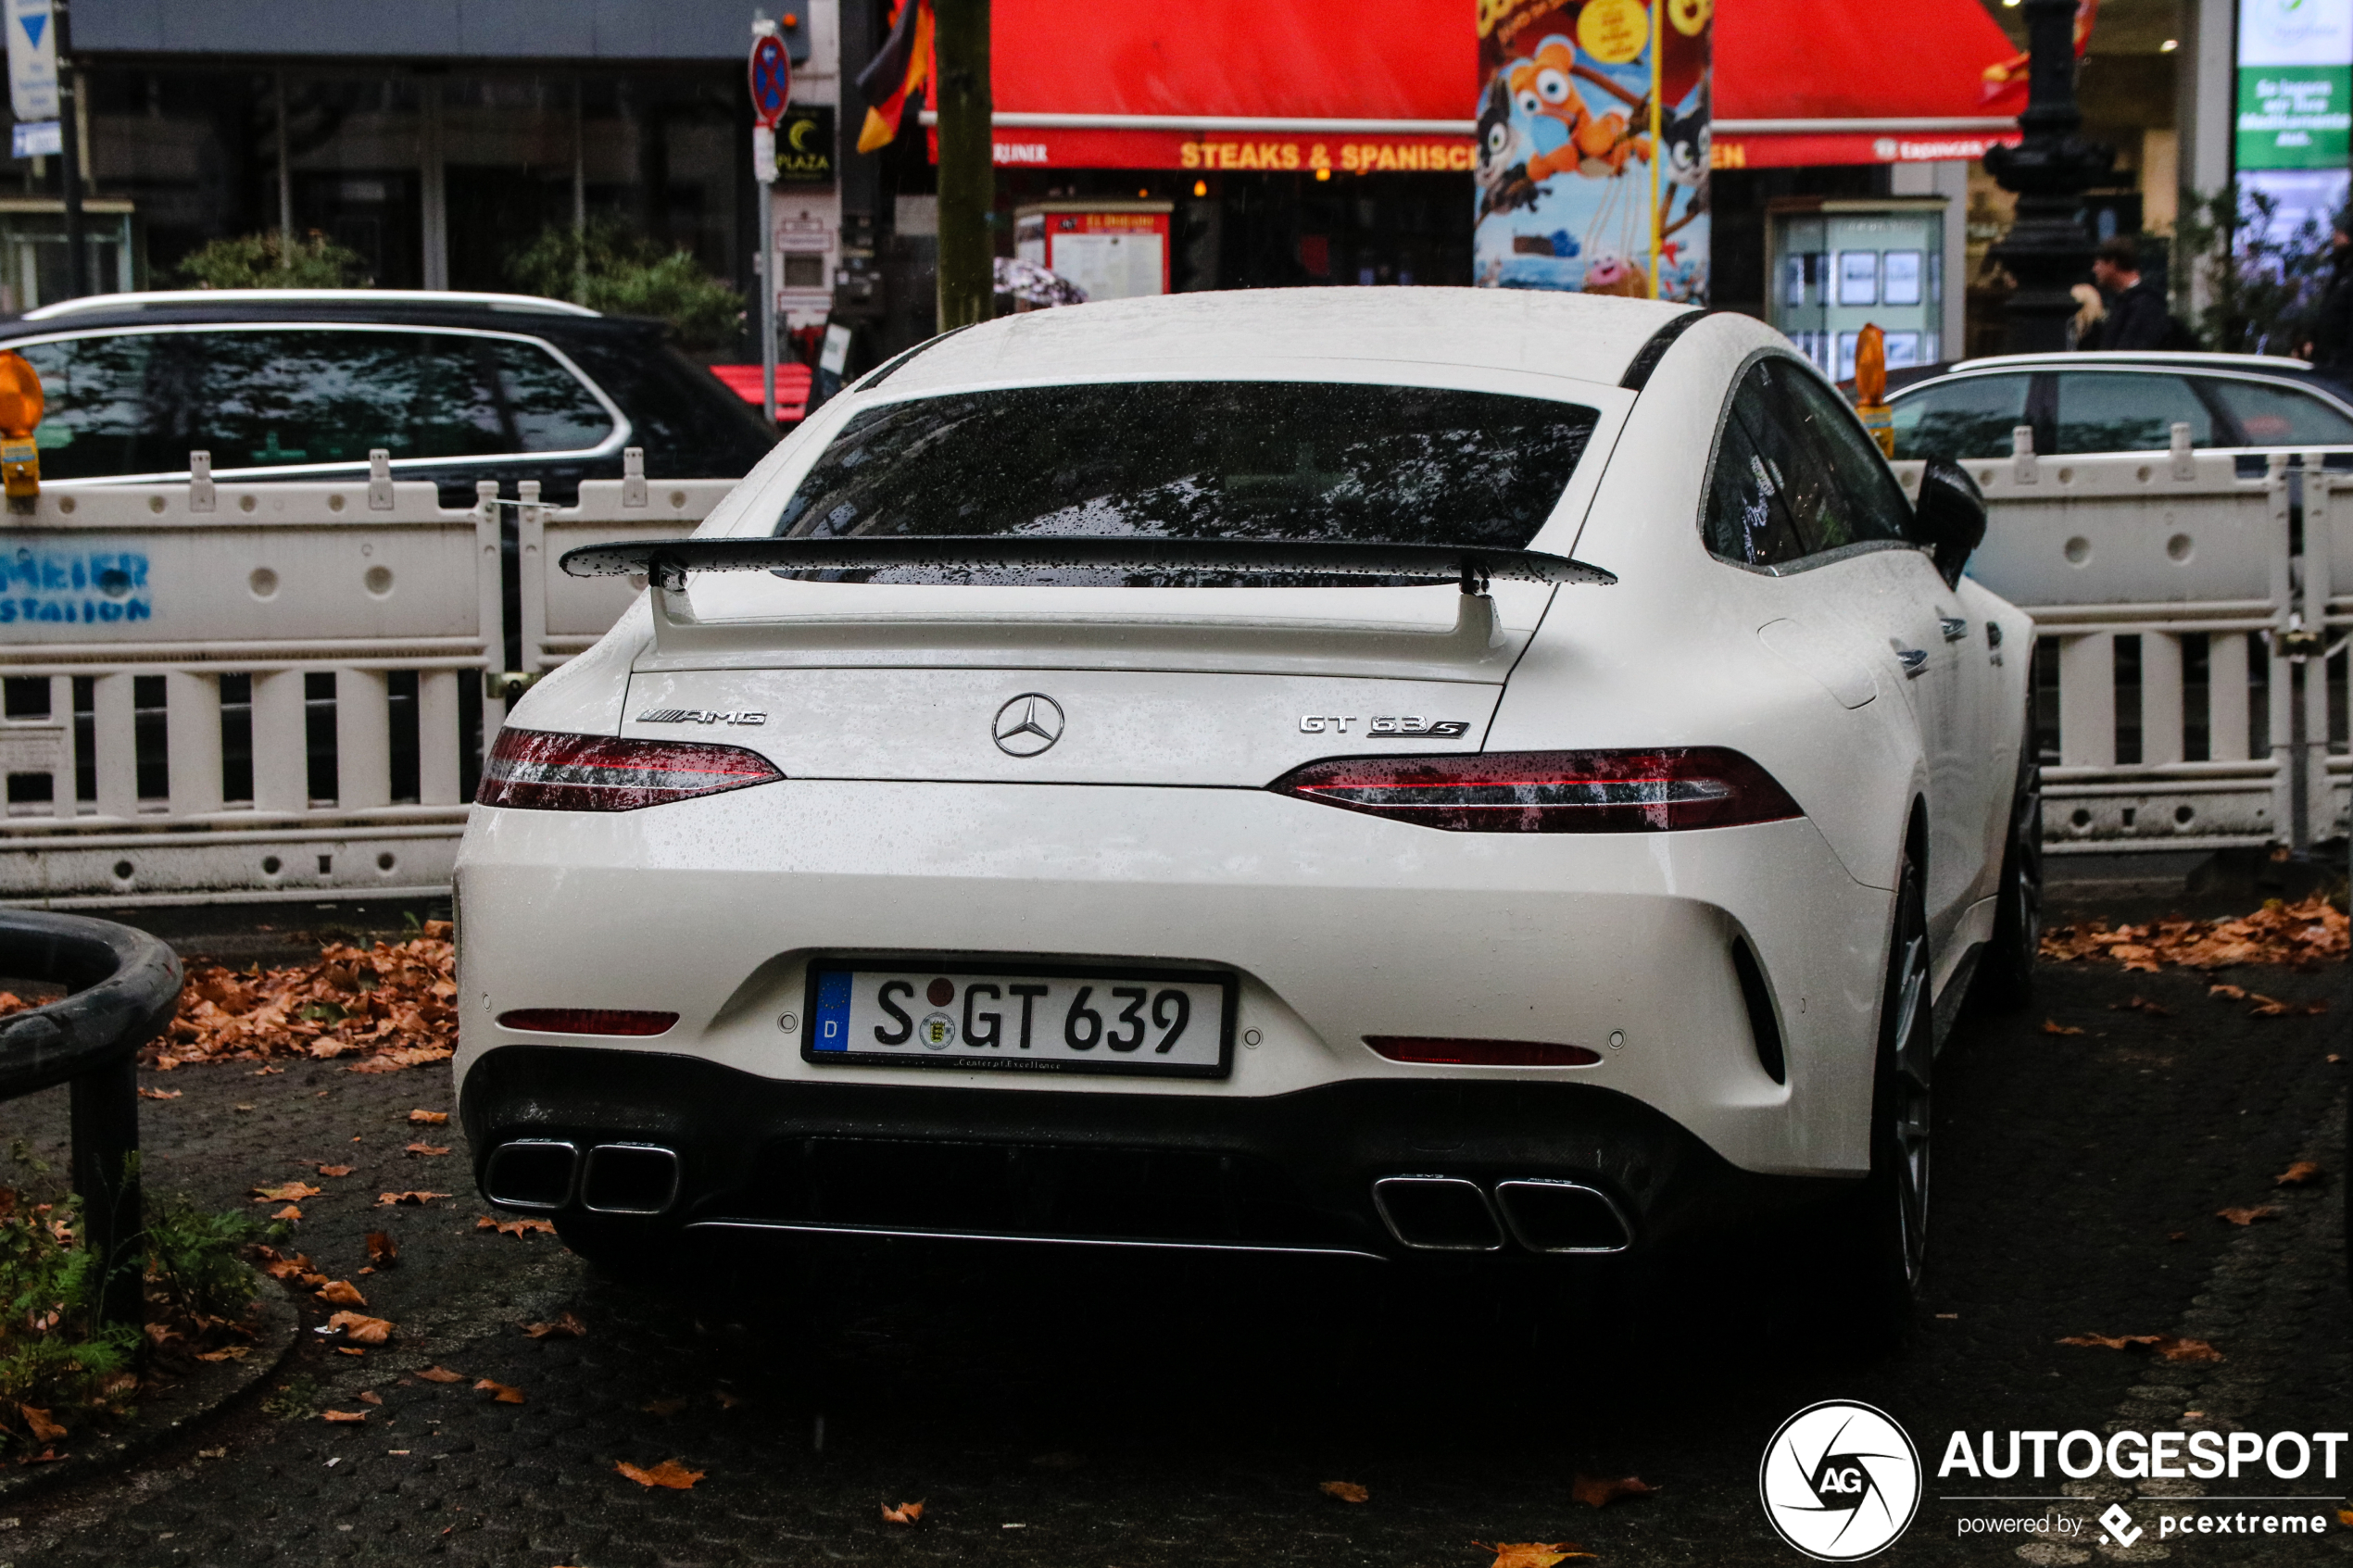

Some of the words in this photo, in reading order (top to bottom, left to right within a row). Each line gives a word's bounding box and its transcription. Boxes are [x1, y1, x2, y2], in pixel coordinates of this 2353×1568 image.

[776, 153, 830, 170] PLAZA
[1181, 142, 1299, 169] STEAKS
[1309, 143, 1331, 169] &
[680, 709, 768, 726] AMG
[1299, 714, 1357, 734] GT
[1370, 715, 1428, 734] 63
[873, 979, 915, 1046] S
[961, 983, 1049, 1049] GT
[1064, 985, 1191, 1054] 639
[823, 1020, 838, 1039] D
